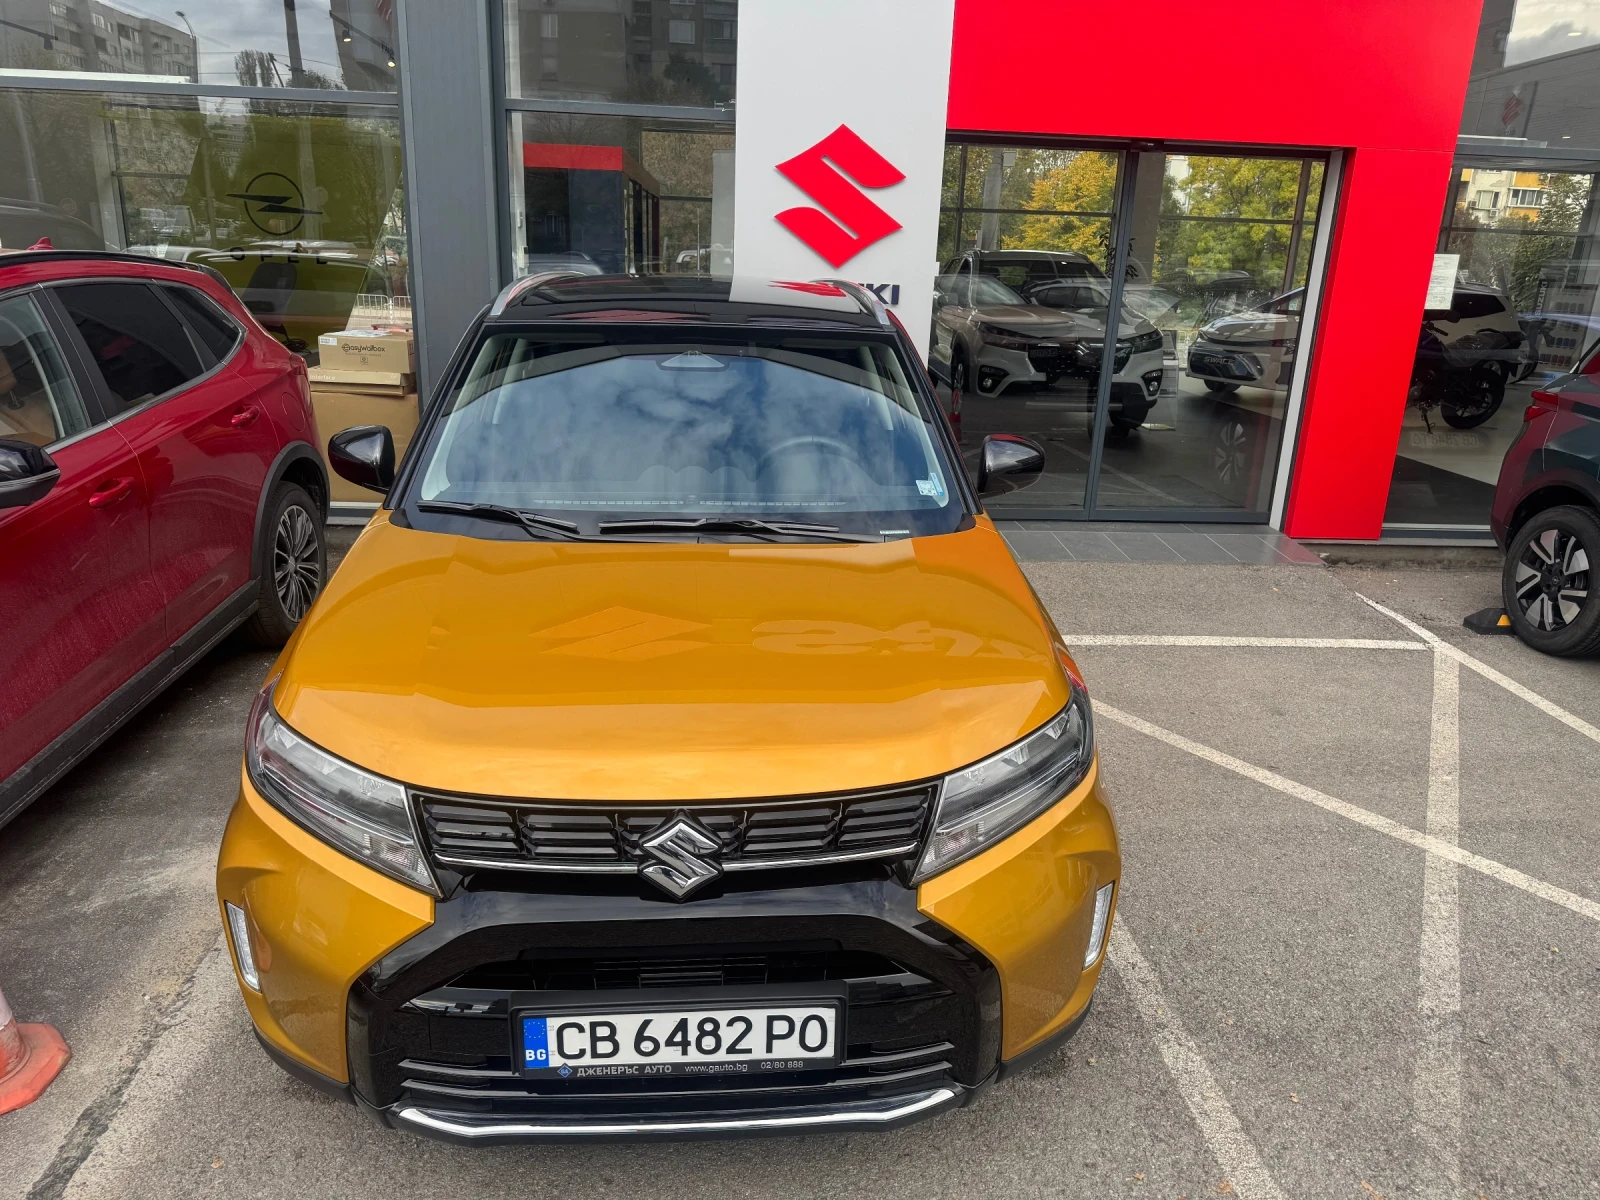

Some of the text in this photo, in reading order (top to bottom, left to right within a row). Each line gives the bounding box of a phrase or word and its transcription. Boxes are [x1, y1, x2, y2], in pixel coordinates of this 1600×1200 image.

[230, 247, 328, 264] OPEL
[1535, 281, 1548, 316] SUZUKI
[1204, 356, 1235, 366] SWACE
[556, 1014, 828, 1060] CB 6482 PO
[525, 1049, 547, 1061] BG
[576, 1064, 673, 1077] ДЖЕНЕРЪС АУТО
[684, 1062, 748, 1073] www.gauto.bg
